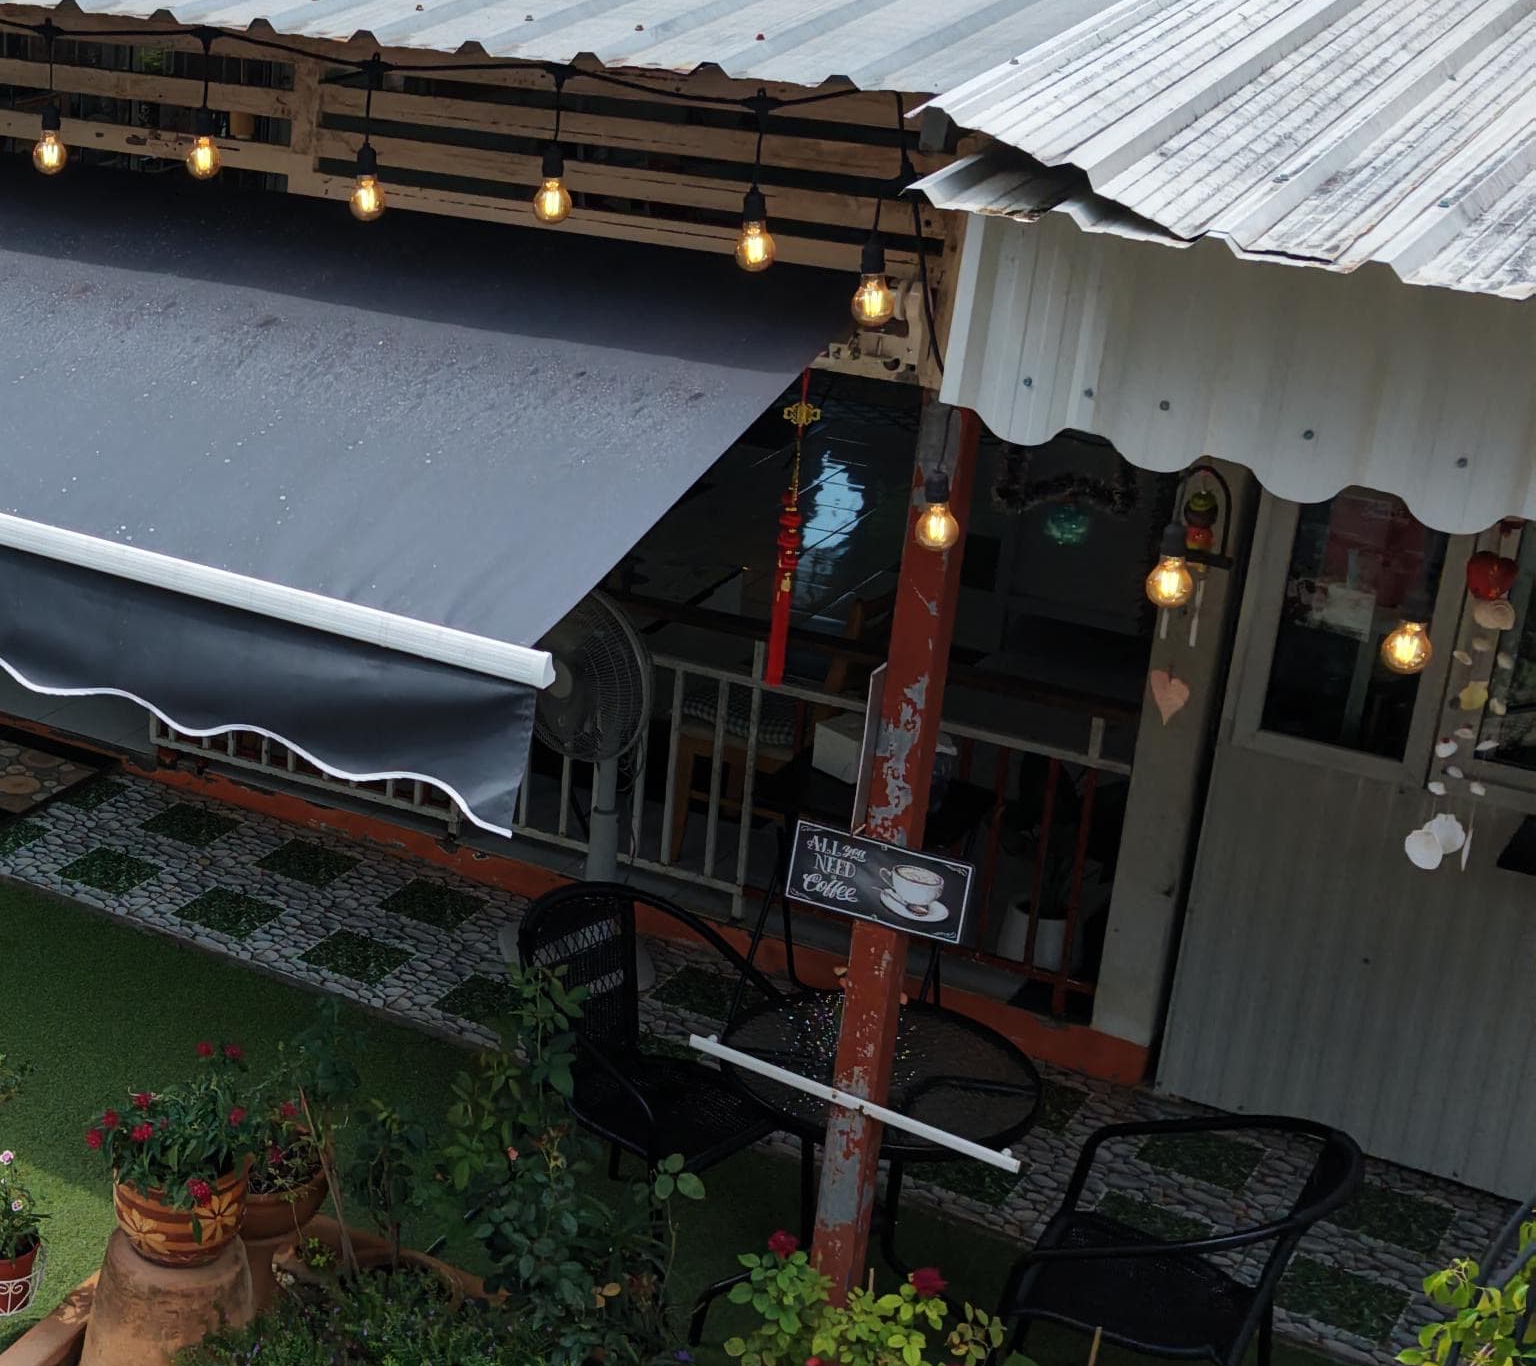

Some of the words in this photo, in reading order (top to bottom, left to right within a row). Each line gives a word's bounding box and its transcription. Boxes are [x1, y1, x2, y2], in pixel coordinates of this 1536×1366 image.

[807, 834, 841, 857] ALL
[842, 844, 867, 863] you
[813, 852, 857, 878] NEED
[802, 873, 859, 903] Coffee
